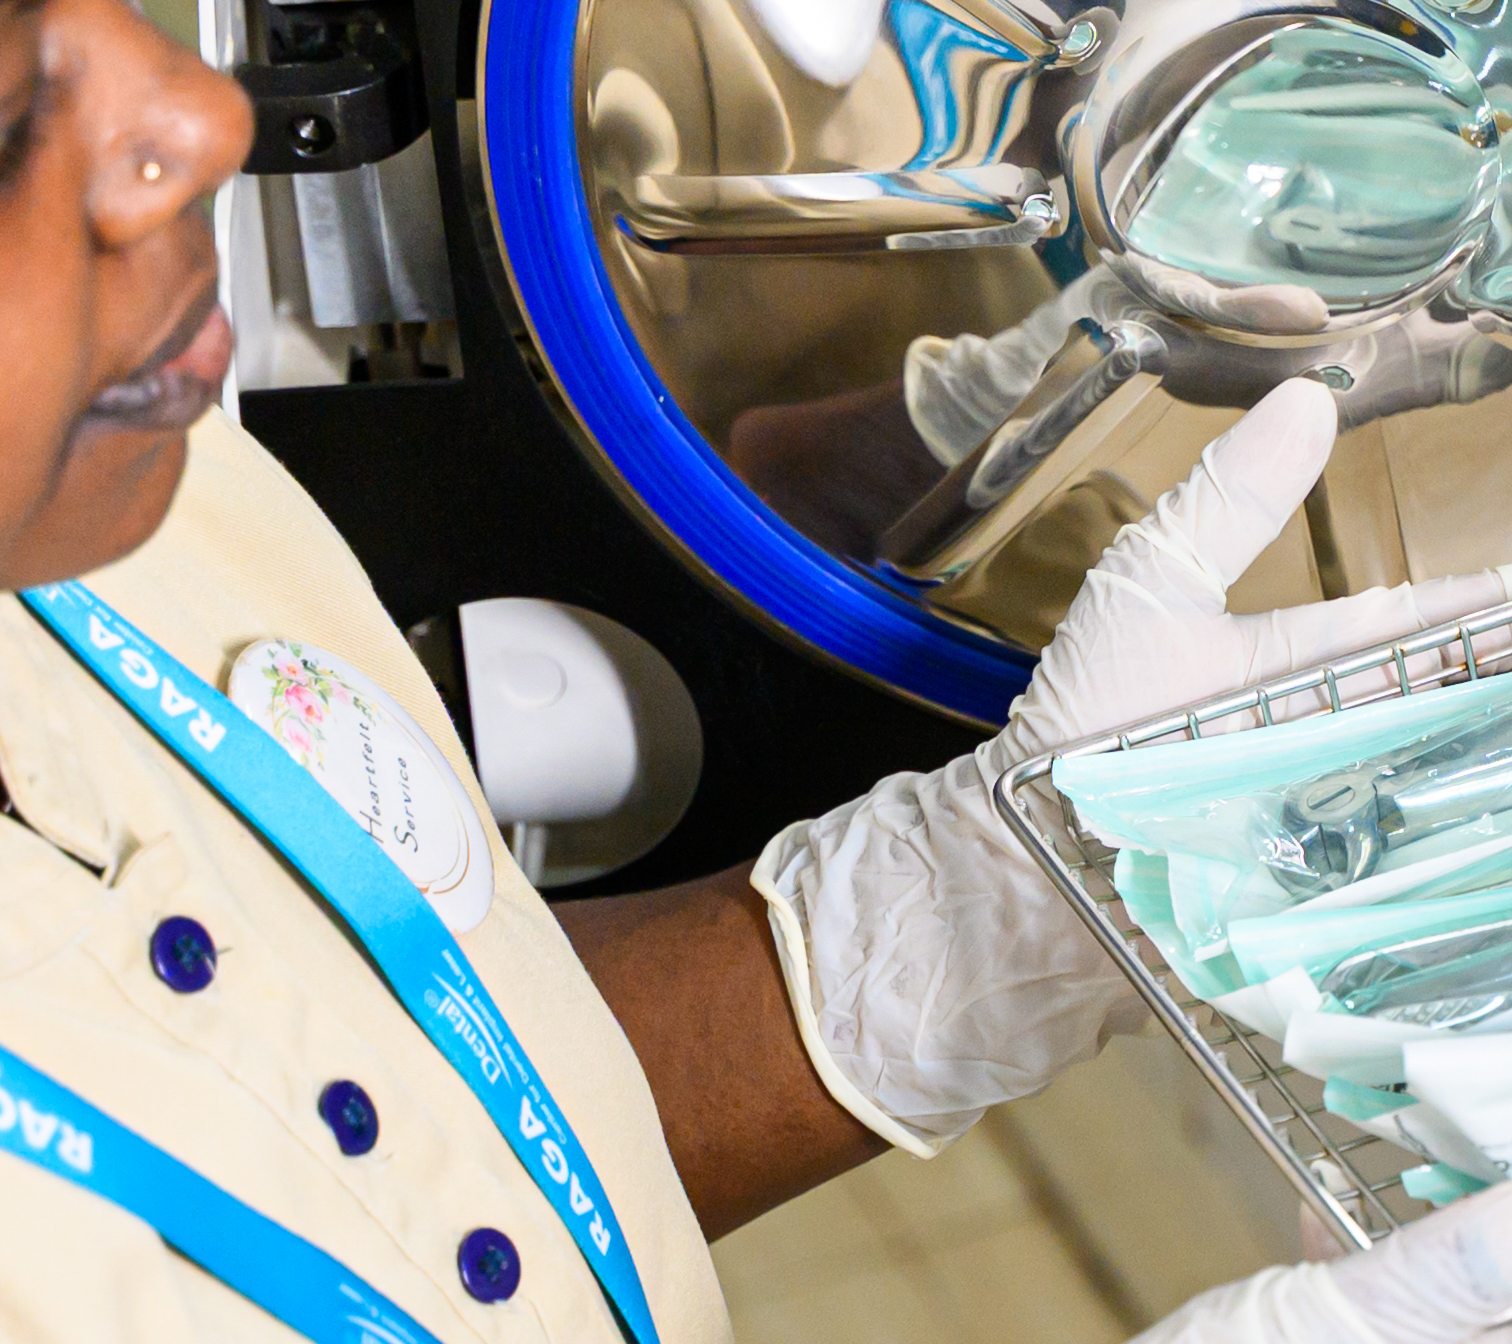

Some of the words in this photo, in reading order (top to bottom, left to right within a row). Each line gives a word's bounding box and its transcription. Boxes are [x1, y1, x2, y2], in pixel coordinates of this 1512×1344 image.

[89, 613, 227, 752] RAGA
[359, 722, 384, 844] Heartfelt
[394, 757, 419, 853] Service
[438, 995, 501, 1085] Dental
[519, 1095, 611, 1256] RAGA
